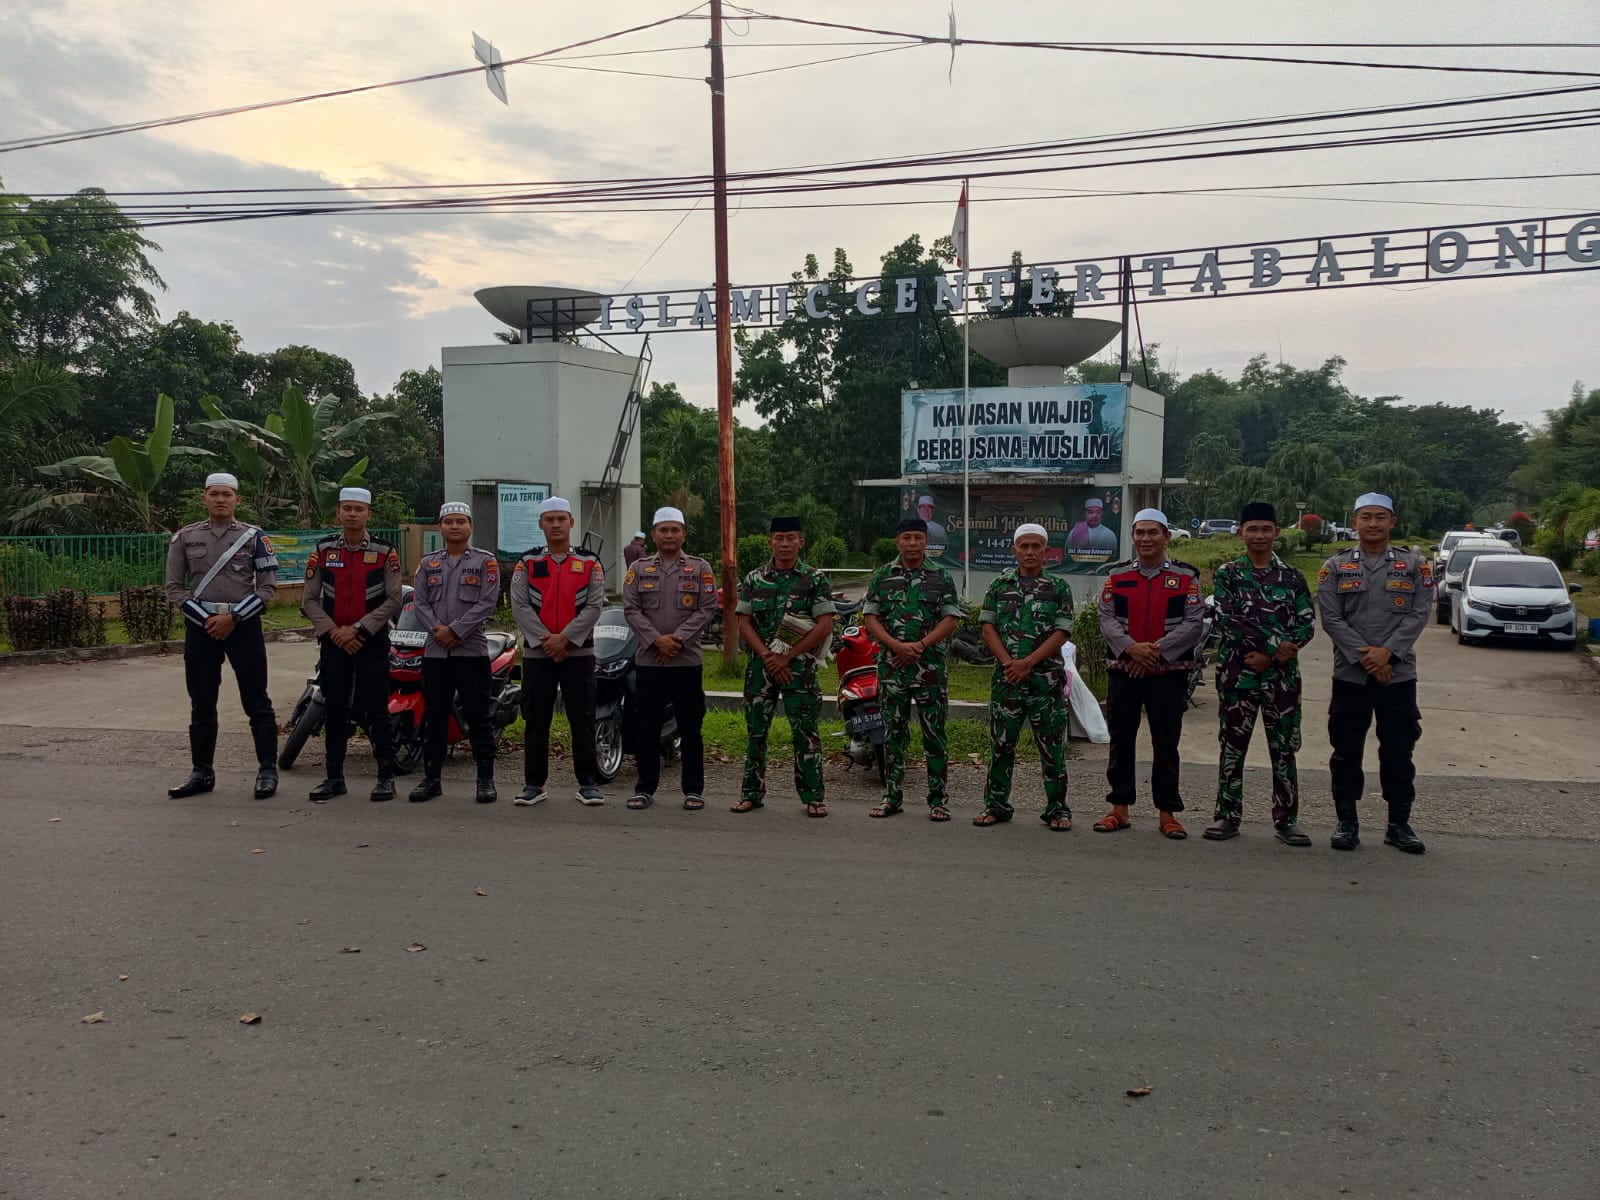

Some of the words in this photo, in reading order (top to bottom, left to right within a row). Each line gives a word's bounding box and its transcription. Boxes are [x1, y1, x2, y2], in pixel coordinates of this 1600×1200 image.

[599, 283, 831, 331] ISLAMIC
[856, 264, 1105, 315] CENTER
[1142, 218, 1600, 296] TABALONG
[933, 402, 1022, 428] KAWASAN
[1029, 400, 1093, 424] WAJIB
[917, 435, 1022, 461] BERBUSANA
[1029, 434, 1110, 459] MUSLIM
[500, 493, 518, 503] TATA
[986, 538, 1012, 549] 1447
